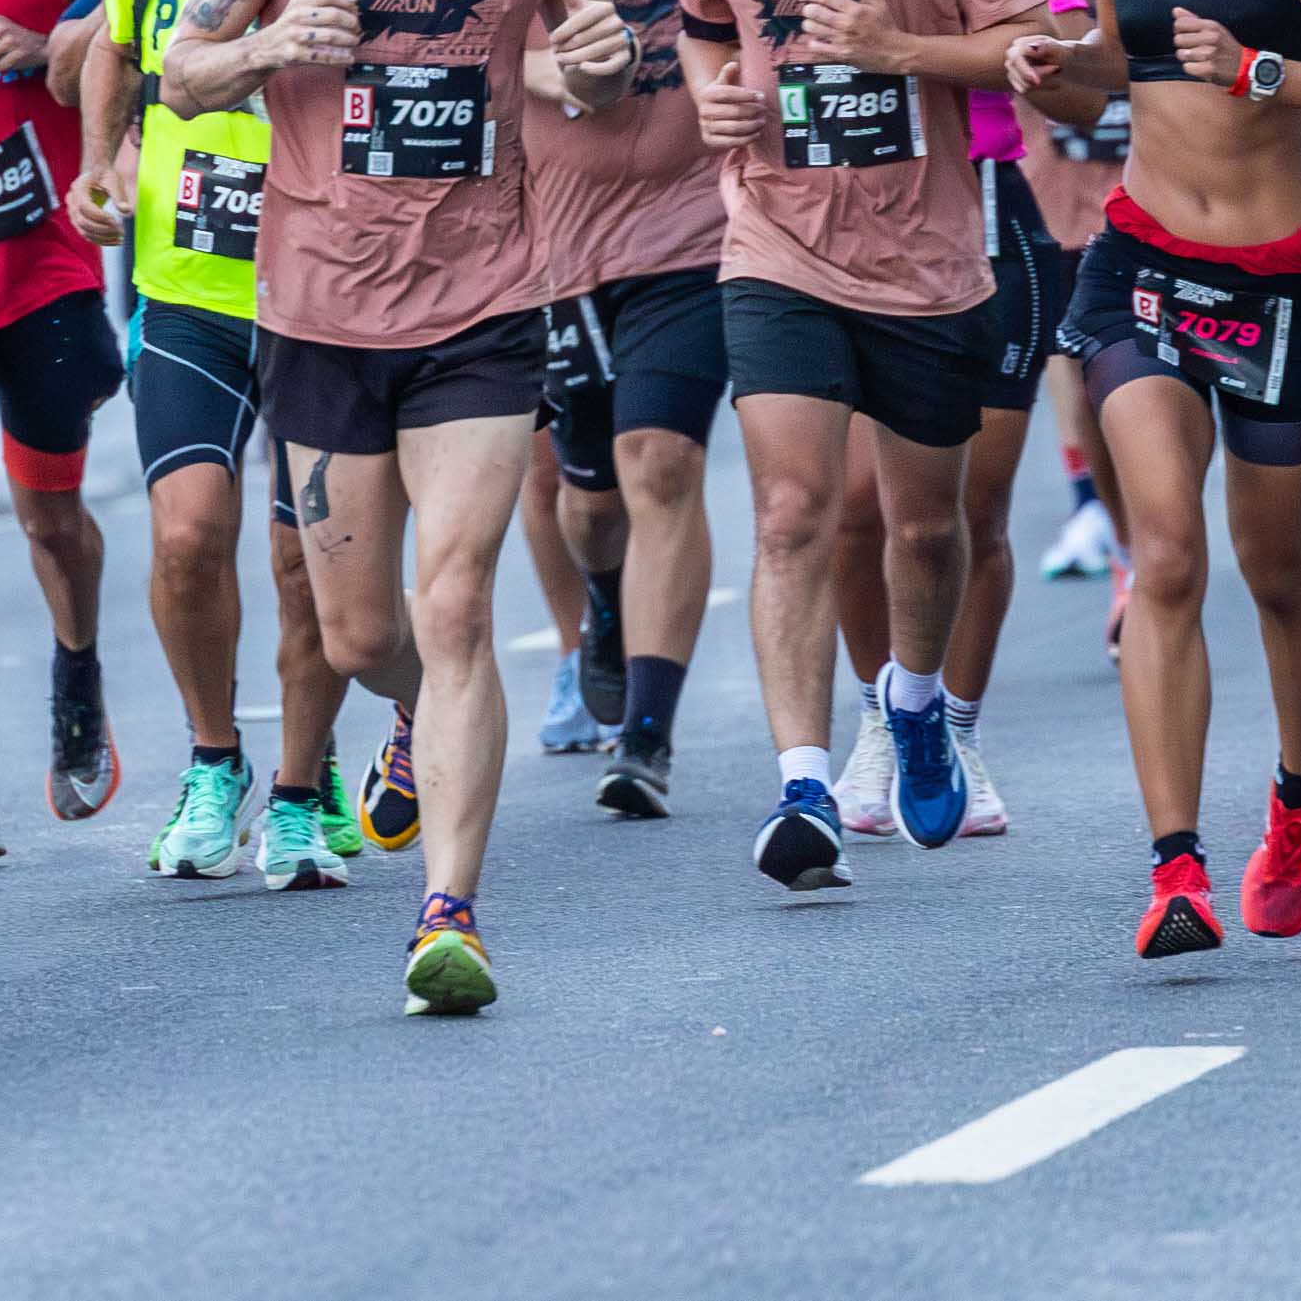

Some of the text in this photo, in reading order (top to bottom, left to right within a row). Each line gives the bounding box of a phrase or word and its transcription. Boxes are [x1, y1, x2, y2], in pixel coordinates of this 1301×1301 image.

[351, 93, 364, 120] B
[389, 99, 475, 127] 7076
[786, 93, 797, 117] C
[820, 88, 899, 119] 7286
[183, 176, 194, 200] B
[1175, 310, 1262, 347] 7079
